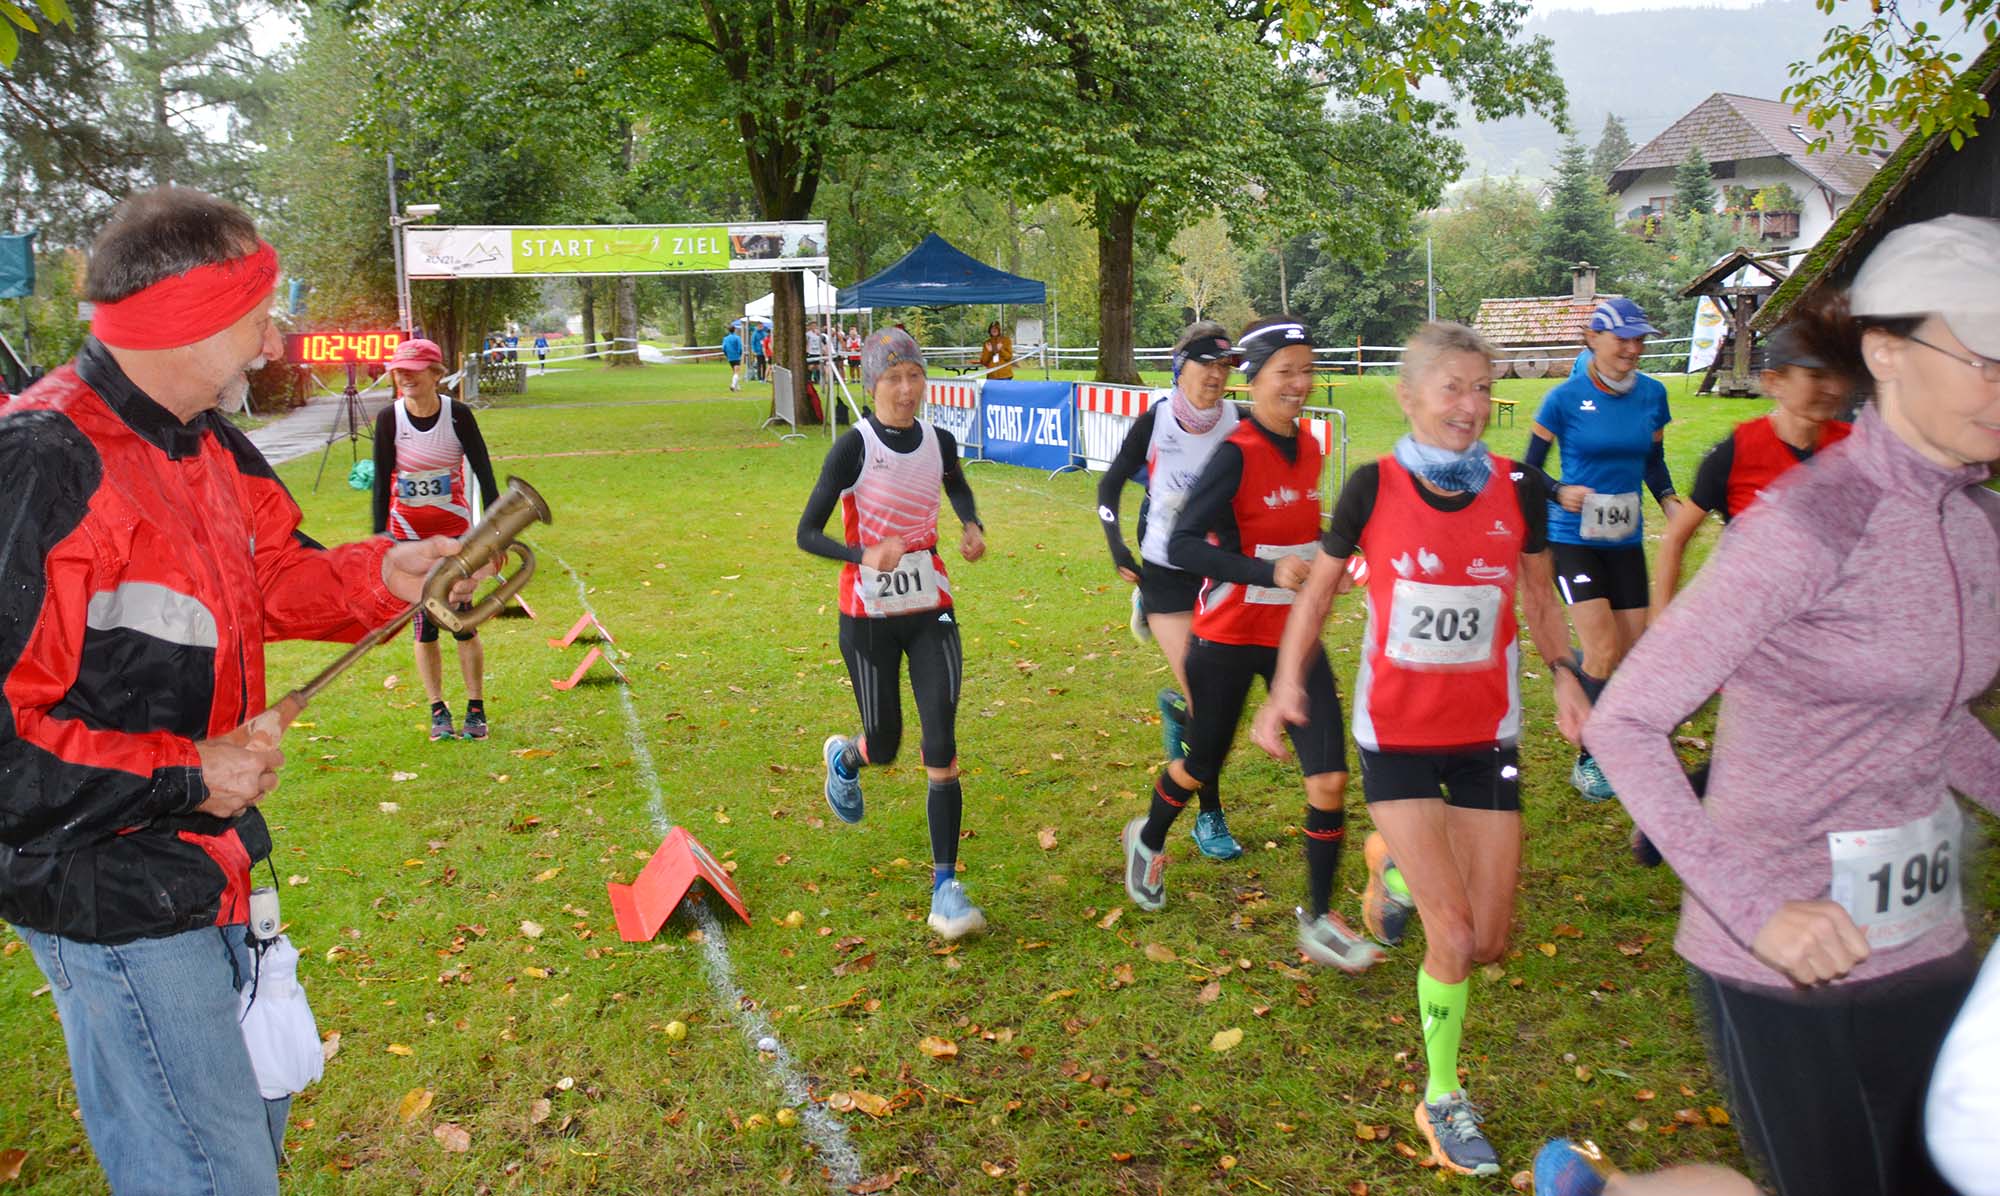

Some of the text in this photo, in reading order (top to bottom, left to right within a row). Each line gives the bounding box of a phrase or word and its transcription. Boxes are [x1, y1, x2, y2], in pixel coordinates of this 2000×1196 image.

[522, 237, 720, 257] START ZIEL
[302, 333, 400, 361] 10:24:09
[986, 403, 1024, 443] START
[1024, 407, 1034, 443] /
[1034, 407, 1069, 447] ZIEL
[407, 479, 442, 497] 333
[1593, 504, 1631, 526] 194
[876, 567, 922, 598] 201
[1408, 605, 1480, 642] 203
[1867, 839, 1952, 915] 196
